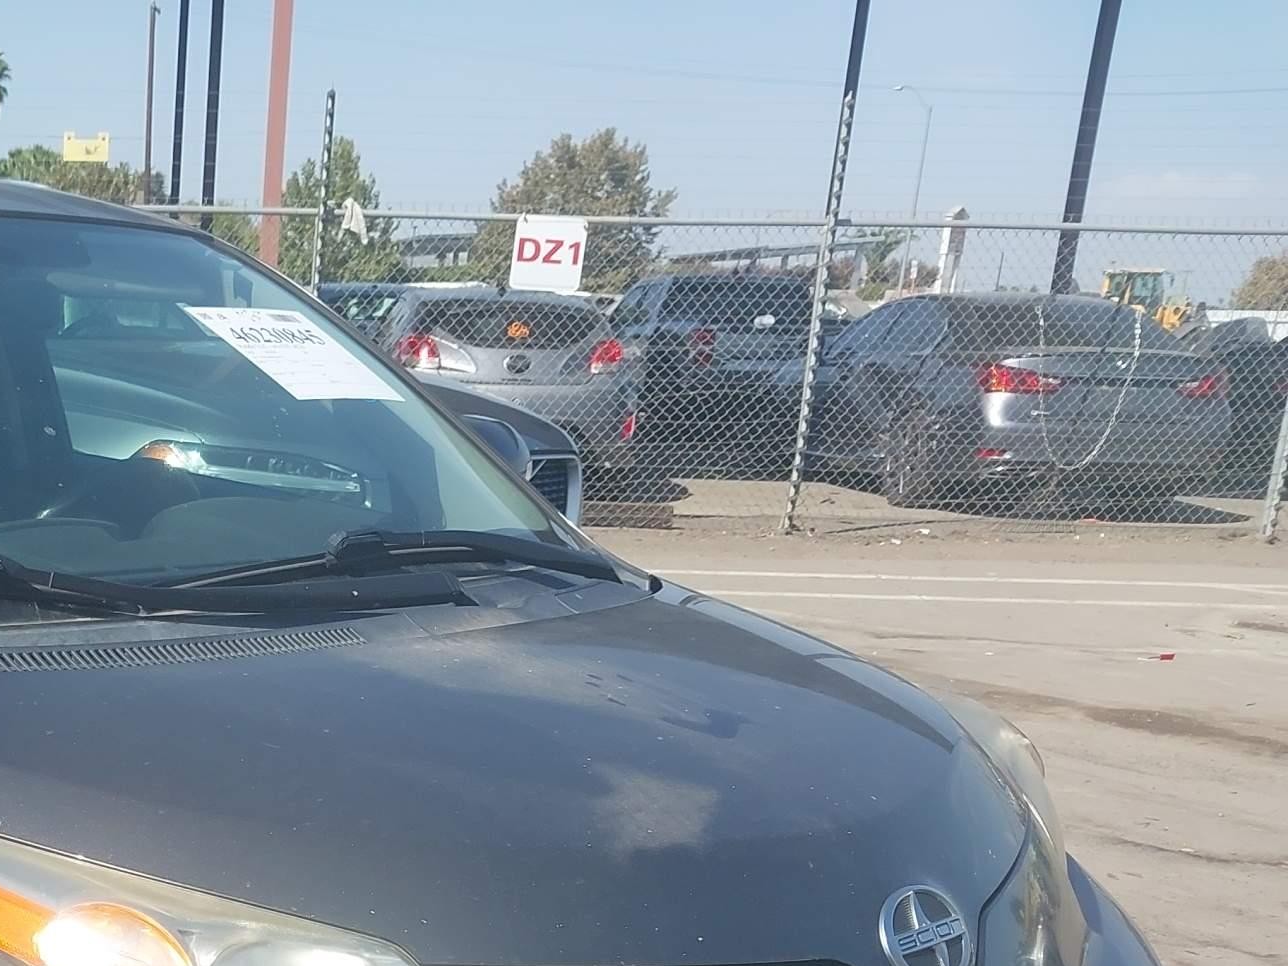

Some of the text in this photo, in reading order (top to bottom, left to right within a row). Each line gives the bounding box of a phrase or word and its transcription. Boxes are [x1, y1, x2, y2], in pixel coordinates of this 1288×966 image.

[516, 237, 581, 265] DZ1
[229, 327, 326, 345] 46230845
[897, 917, 966, 953] SCION
